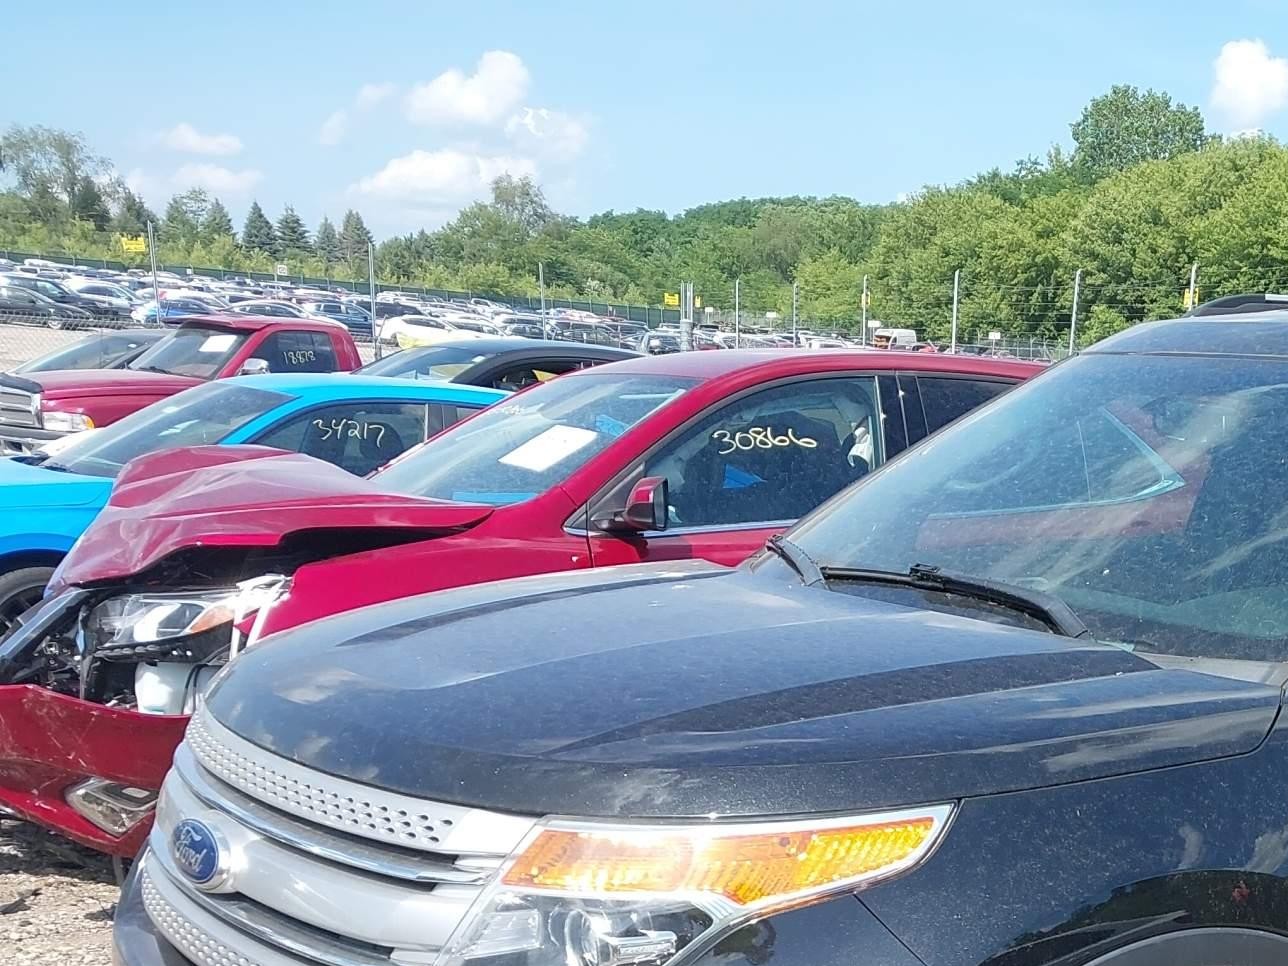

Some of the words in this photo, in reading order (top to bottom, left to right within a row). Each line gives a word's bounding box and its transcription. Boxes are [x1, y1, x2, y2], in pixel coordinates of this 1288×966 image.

[312, 418, 385, 448] 34217
[712, 427, 818, 454] 30866
[175, 826, 207, 873] Ford
